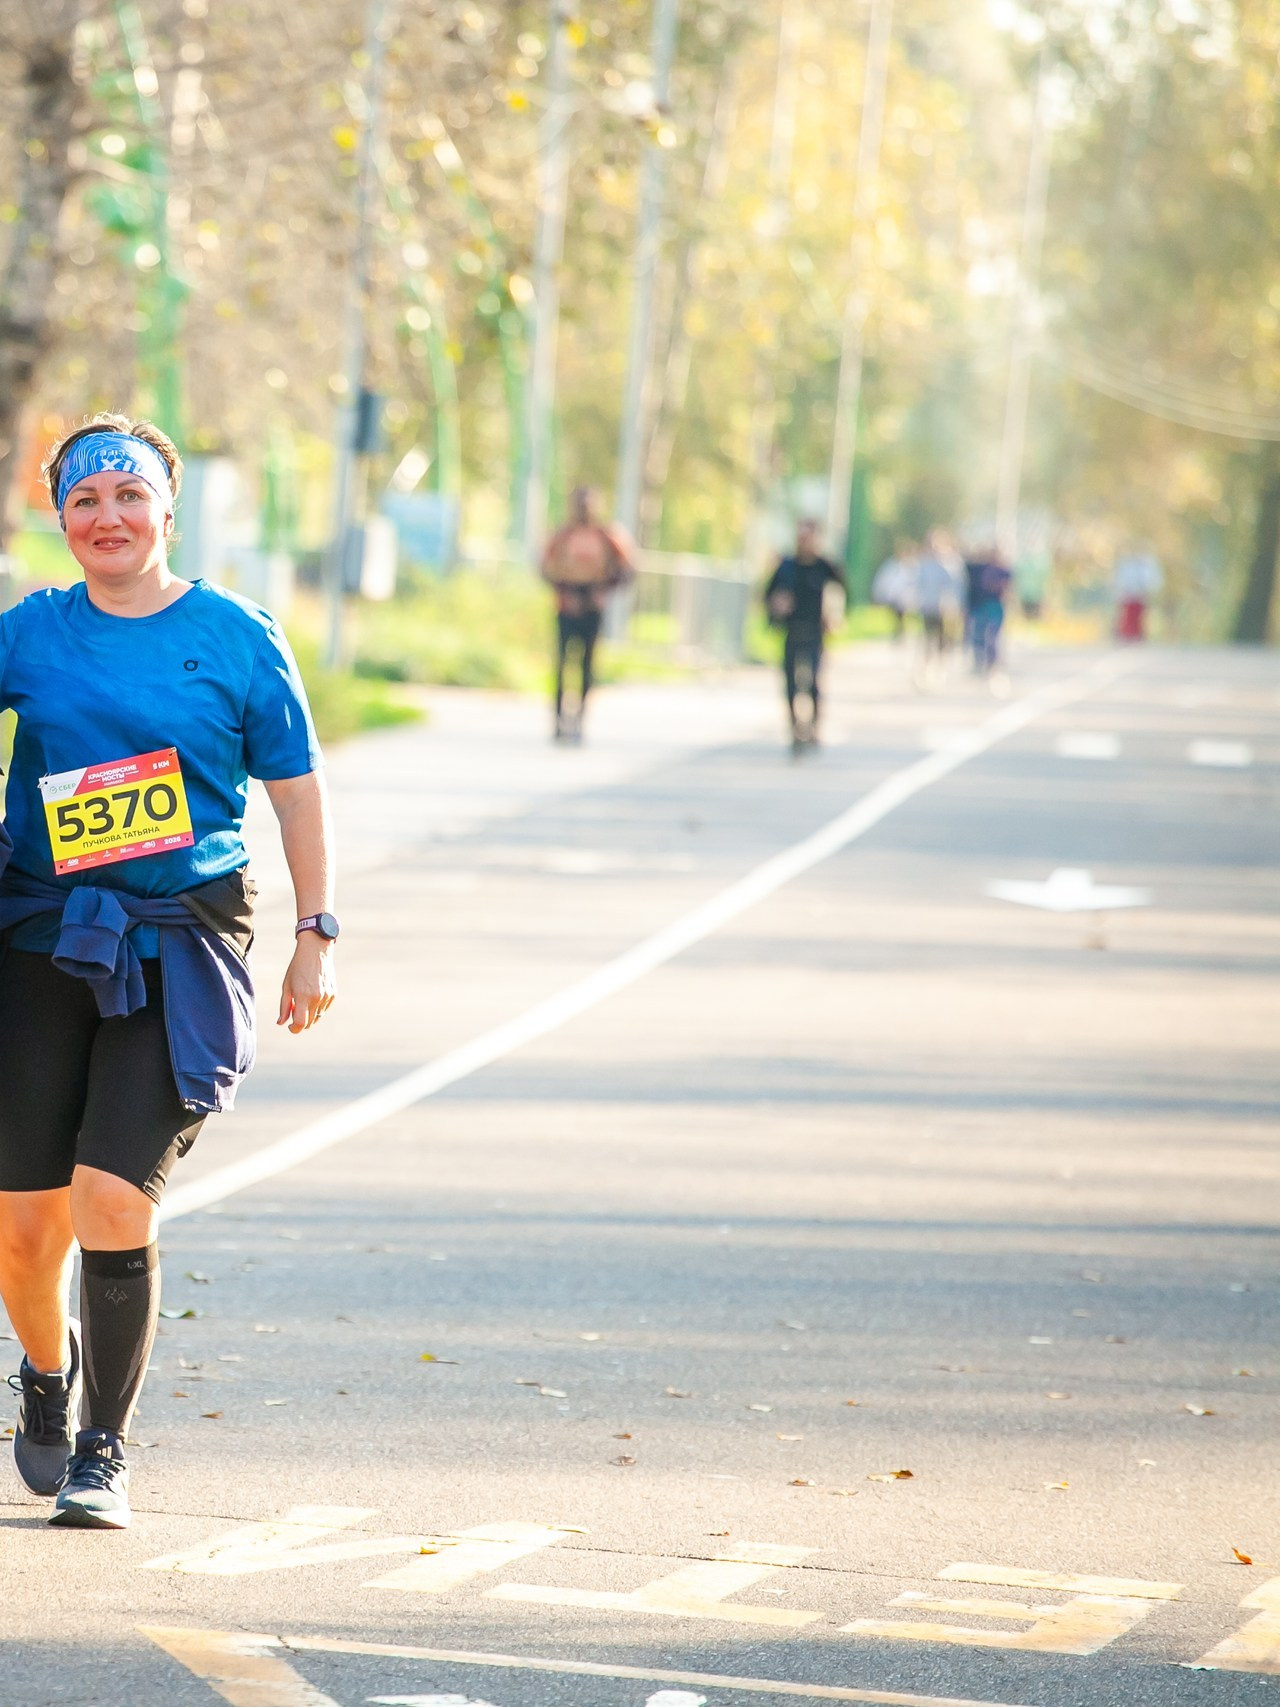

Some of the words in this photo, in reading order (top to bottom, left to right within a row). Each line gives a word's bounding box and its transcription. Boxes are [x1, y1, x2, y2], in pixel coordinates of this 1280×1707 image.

[87, 764, 137, 780] КРАСНОЯРСКИЕ
[102, 773, 125, 782] МОСТЫ
[57, 783, 178, 843] 5370
[82, 834, 122, 849] ПУЧКОВА
[123, 825, 160, 839] ТАТЬЯНА
